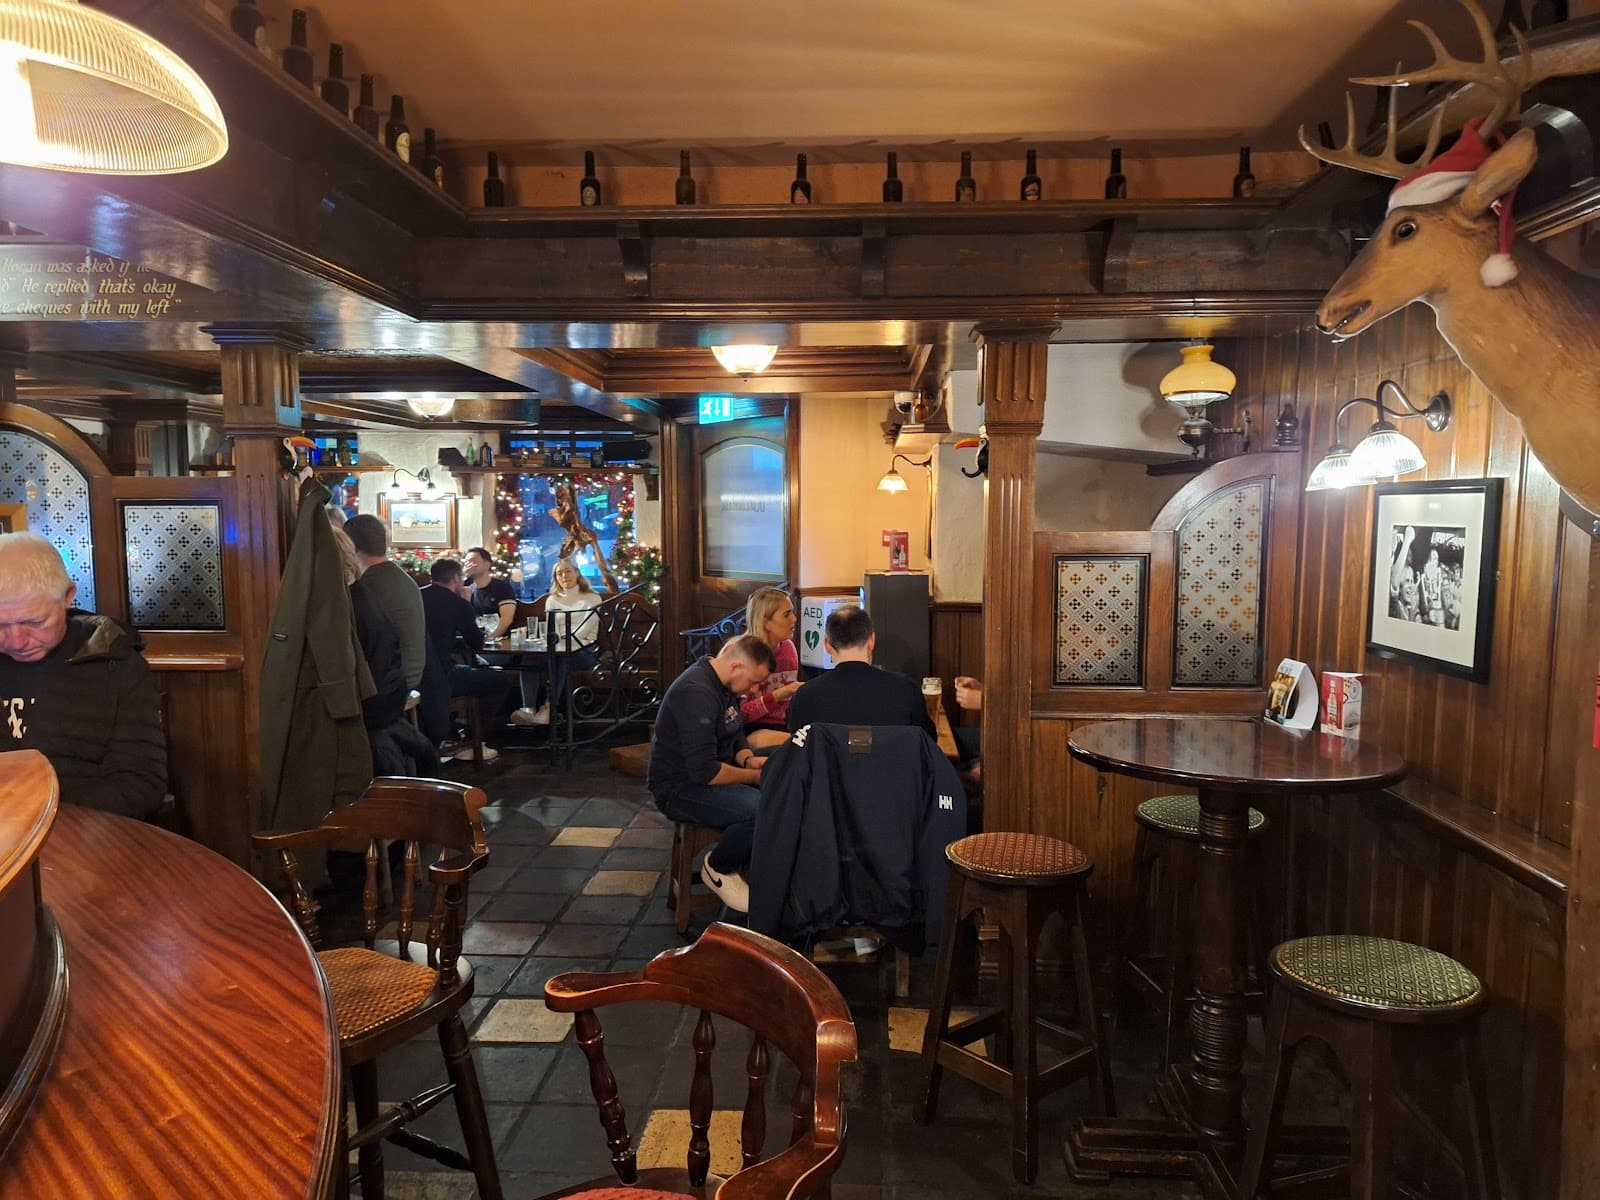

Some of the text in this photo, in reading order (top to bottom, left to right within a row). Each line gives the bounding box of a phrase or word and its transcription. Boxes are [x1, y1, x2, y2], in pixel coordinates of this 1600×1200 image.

[47, 262, 72, 273] was
[76, 258, 114, 273] asked
[22, 278, 38, 293] He
[44, 278, 89, 297] replied
[143, 279, 177, 300] okay
[16, 298, 72, 318] cheques
[80, 299, 112, 314] with
[118, 303, 140, 318] my
[803, 607, 823, 618] AED
[938, 794, 953, 810] HH
